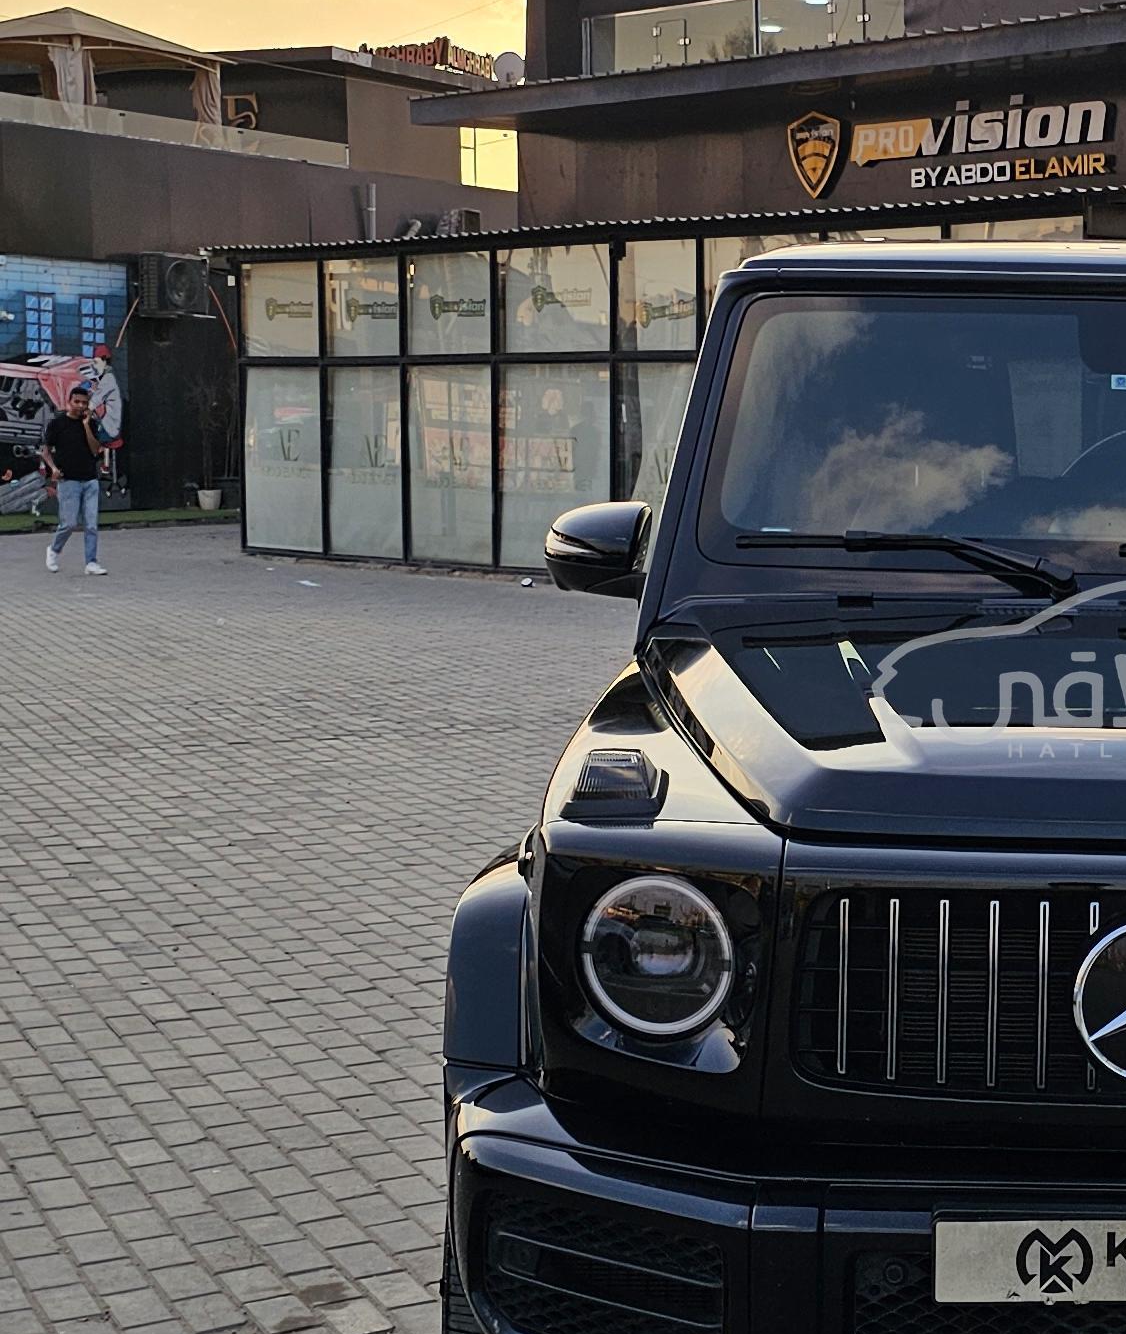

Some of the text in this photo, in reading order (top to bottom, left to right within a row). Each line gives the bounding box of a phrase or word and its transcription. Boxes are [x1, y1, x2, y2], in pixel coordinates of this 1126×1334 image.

[911, 153, 1106, 188] BY ABDO ELAMIR
